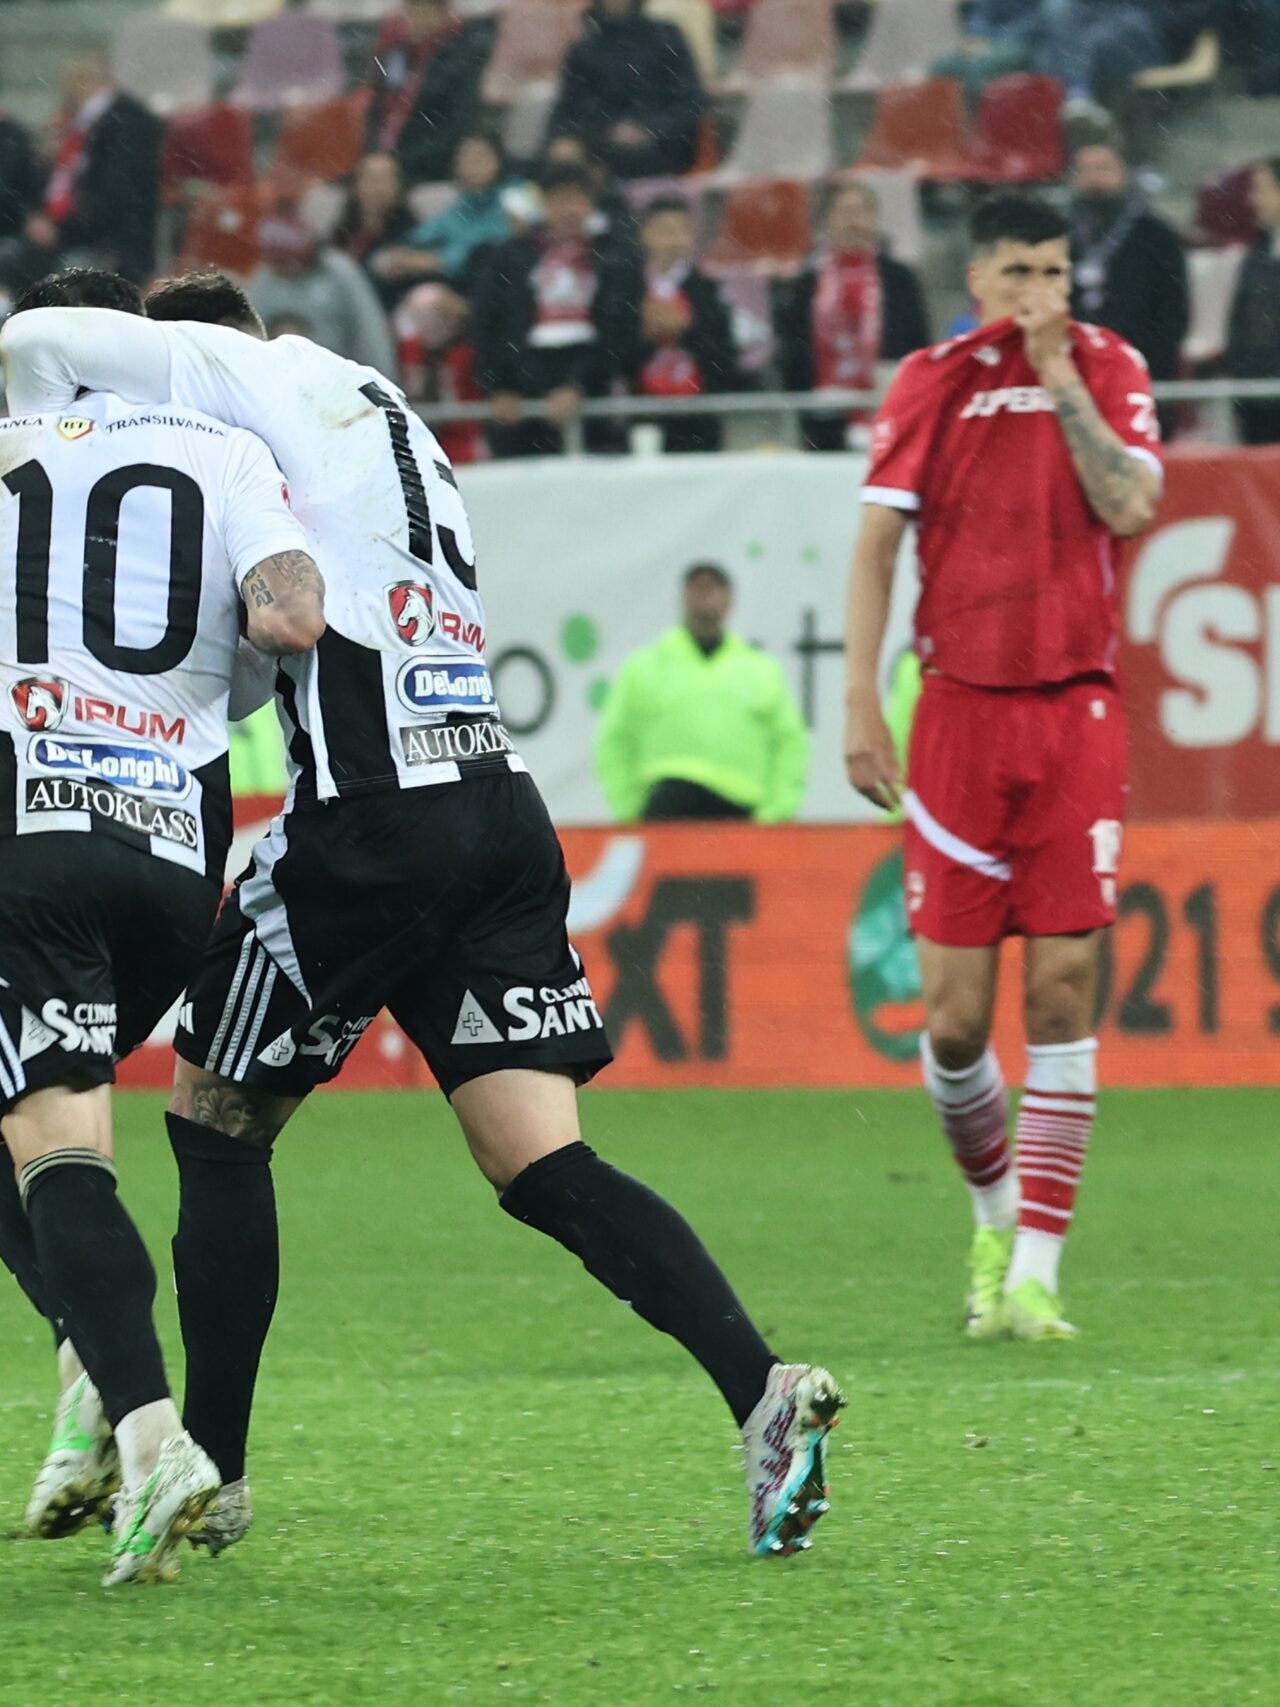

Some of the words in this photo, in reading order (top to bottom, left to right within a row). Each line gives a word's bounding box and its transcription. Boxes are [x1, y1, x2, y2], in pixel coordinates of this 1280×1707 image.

[63, 421, 87, 430] BT
[105, 414, 225, 437] TRANSILVANIA
[1, 458, 205, 676] 10
[74, 696, 186, 745] IRUM
[27, 780, 198, 848] AUTOKLASS
[1093, 880, 1218, 1037] 21
